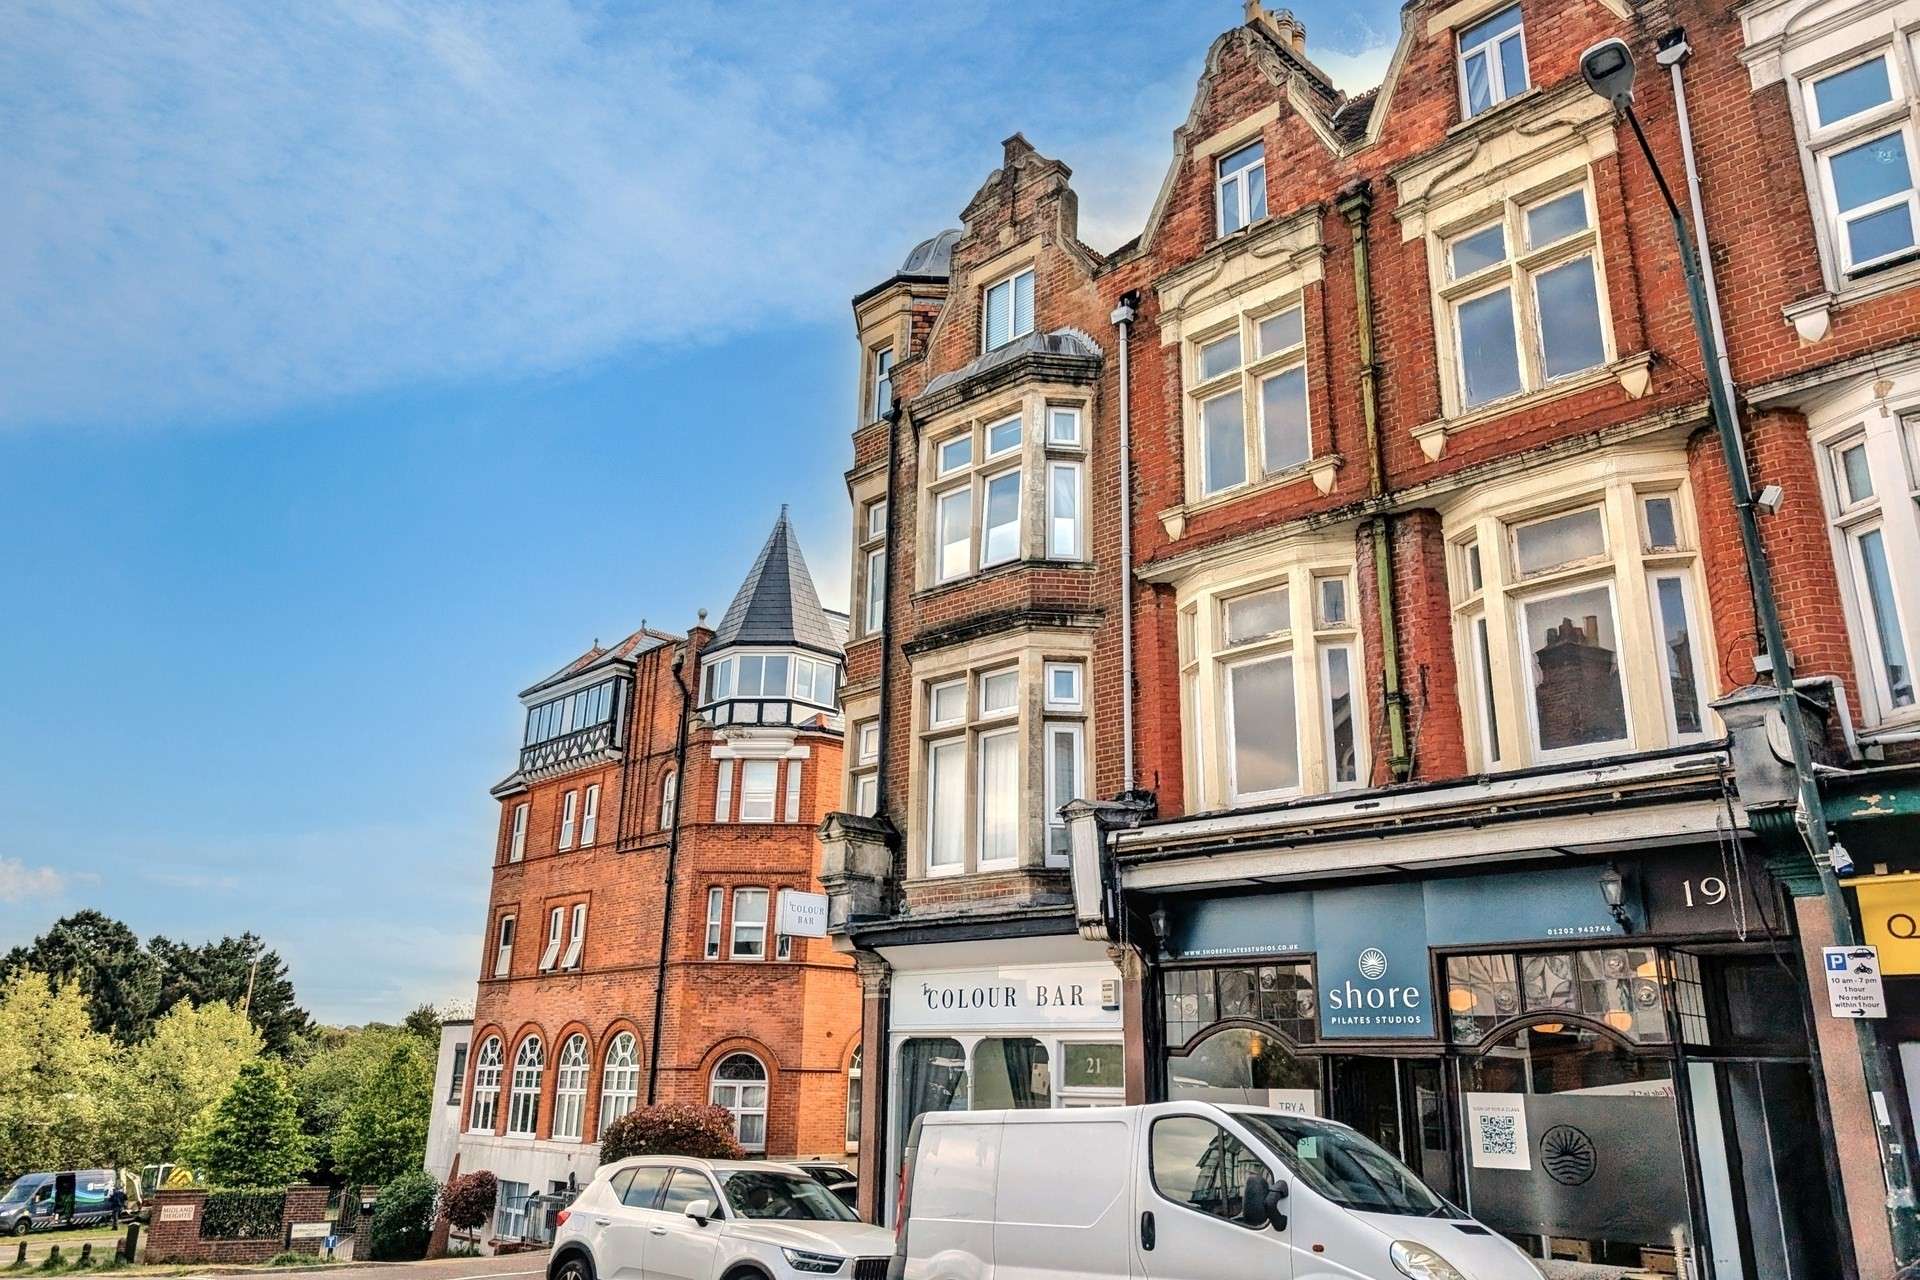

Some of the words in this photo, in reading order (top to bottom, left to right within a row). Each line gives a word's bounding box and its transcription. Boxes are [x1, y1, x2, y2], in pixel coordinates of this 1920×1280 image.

[1682, 876, 1726, 907] 19
[791, 904, 825, 915] COLOUR
[797, 915, 814, 925] BAR
[1547, 927, 1574, 935] 01202
[1184, 944, 1298, 956] WWW.SHOREPILATESSTUDIOS.CO.UK
[1830, 954, 1843, 969] P
[928, 986, 1017, 1010] COLOUR
[1036, 984, 1085, 1007] BAR
[1329, 980, 1420, 1010] shore
[1331, 1016, 1371, 1025] PILATES
[1376, 1015, 1421, 1024] STUDIOS
[1086, 1057, 1100, 1073] 21
[1279, 1102, 1297, 1111] TRY
[1299, 1103, 1306, 1113] A
